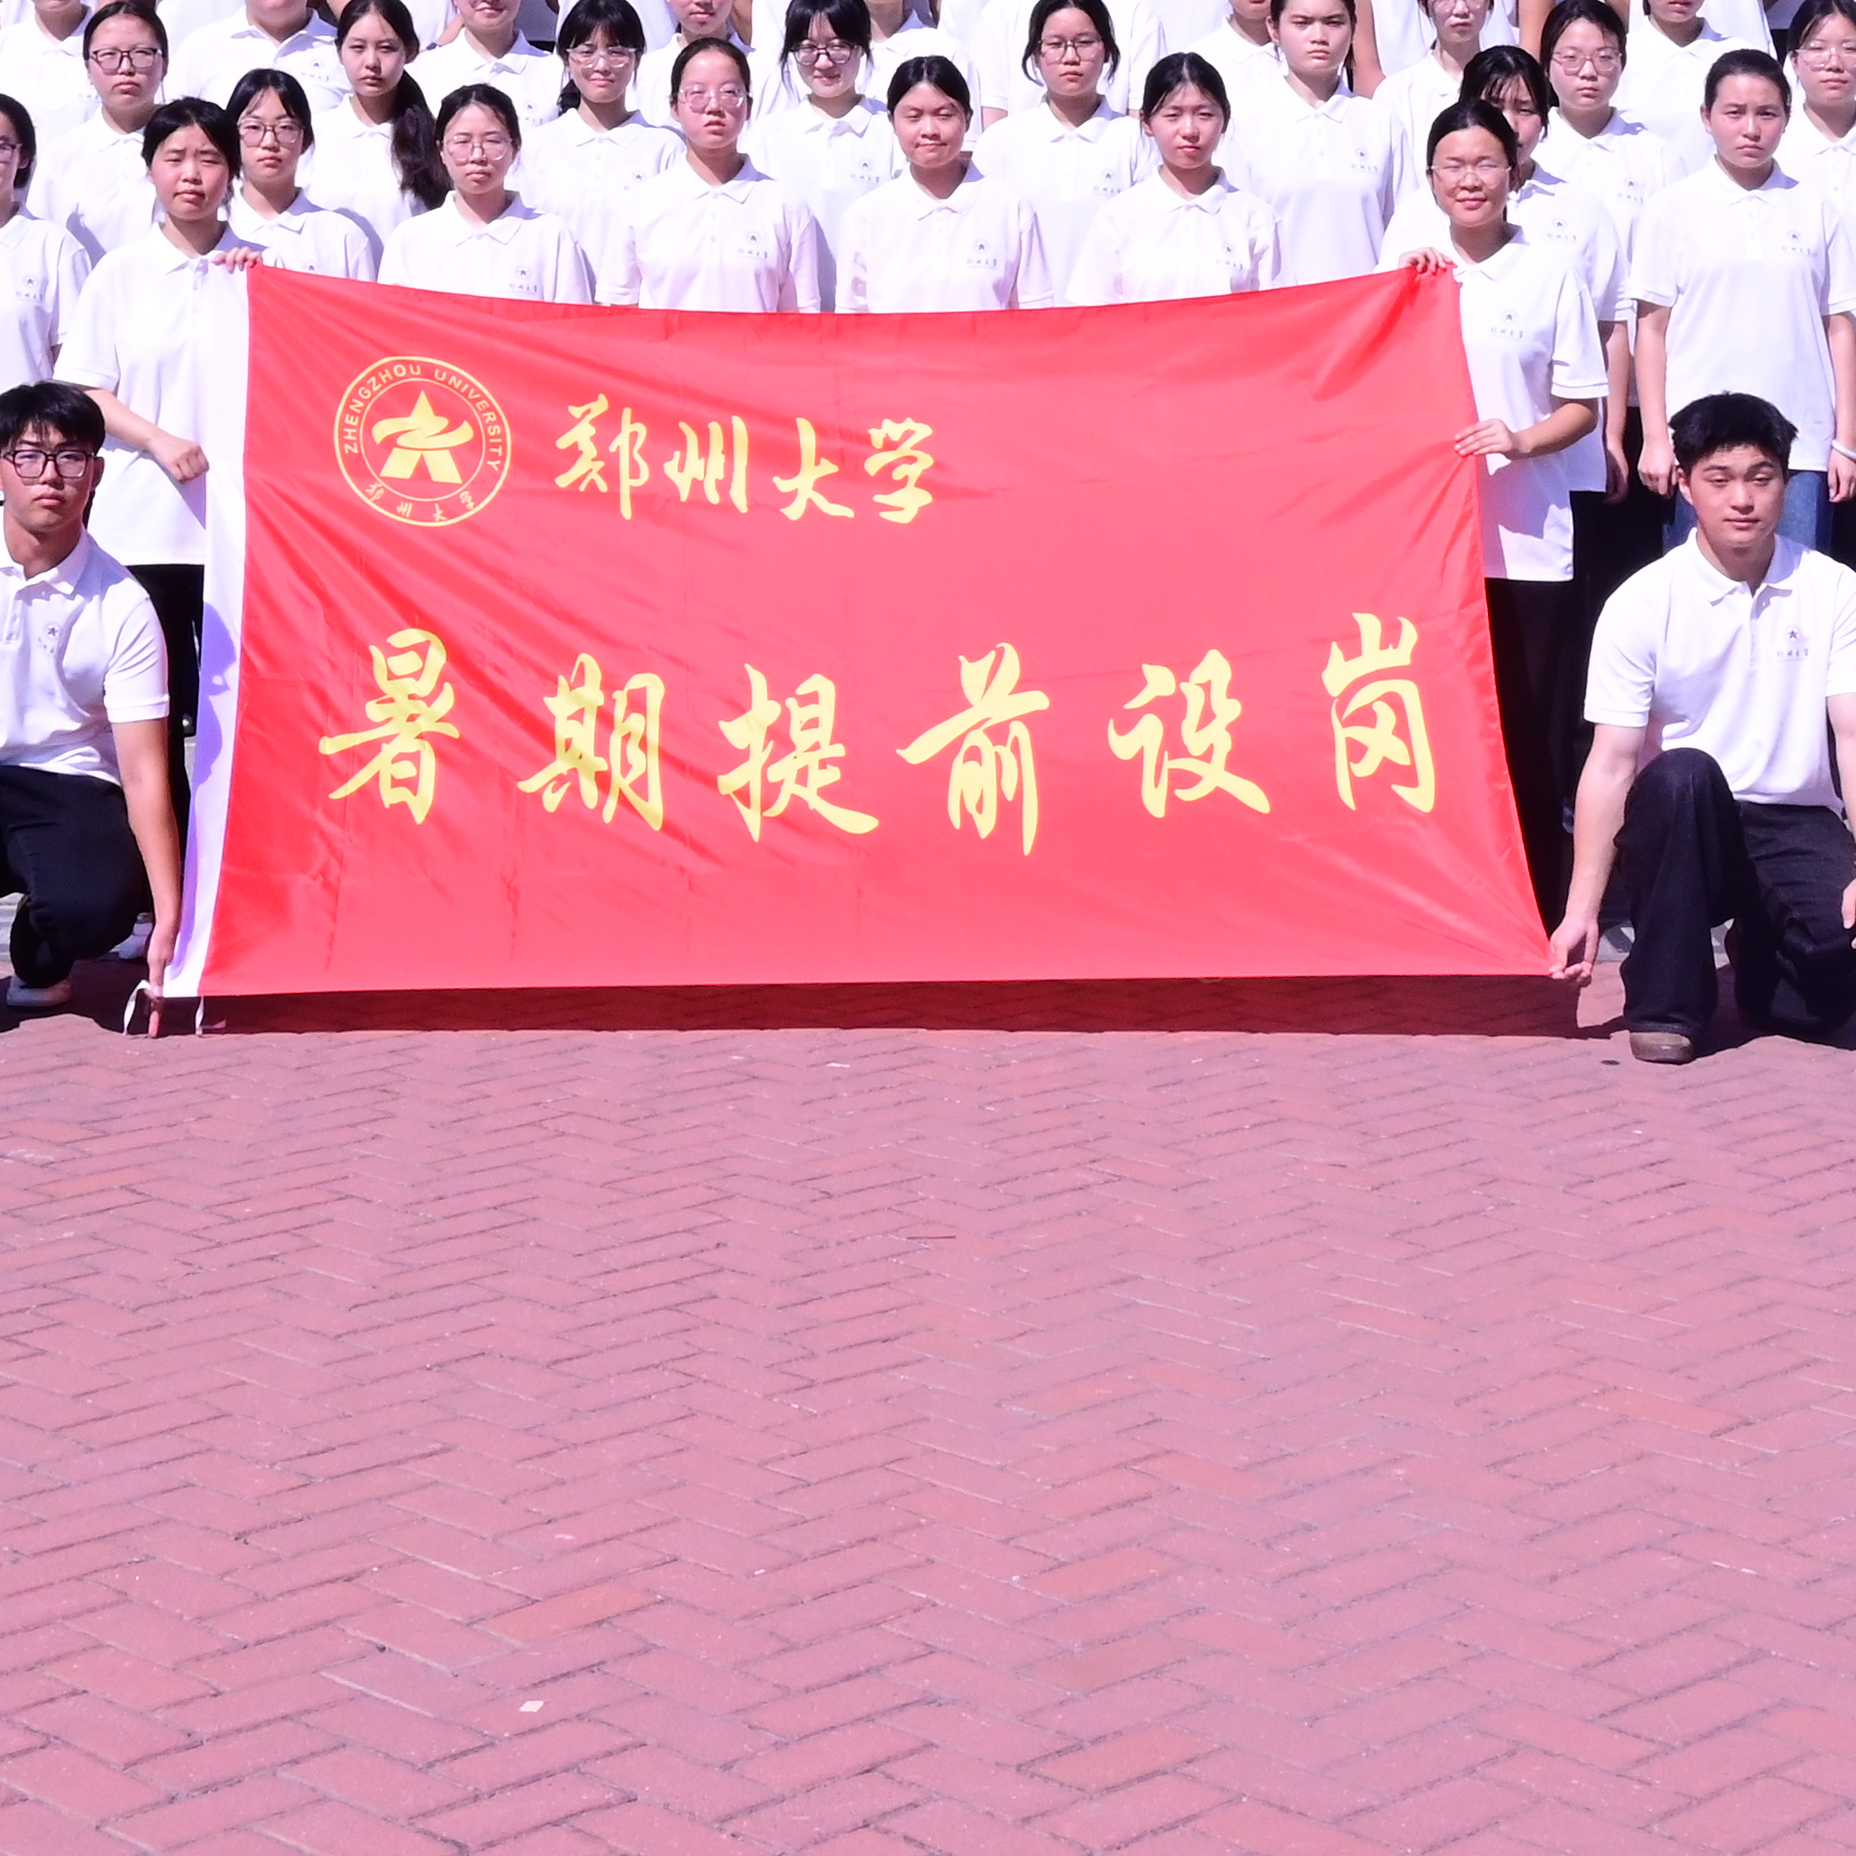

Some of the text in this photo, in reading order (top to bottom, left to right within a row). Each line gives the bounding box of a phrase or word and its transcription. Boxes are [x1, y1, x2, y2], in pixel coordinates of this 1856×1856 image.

[343, 364, 503, 471] ZHENGZHOU UNIVERSITY
[555, 393, 935, 525] 郑州大学
[318, 612, 1436, 857] 暑期提前设岗
